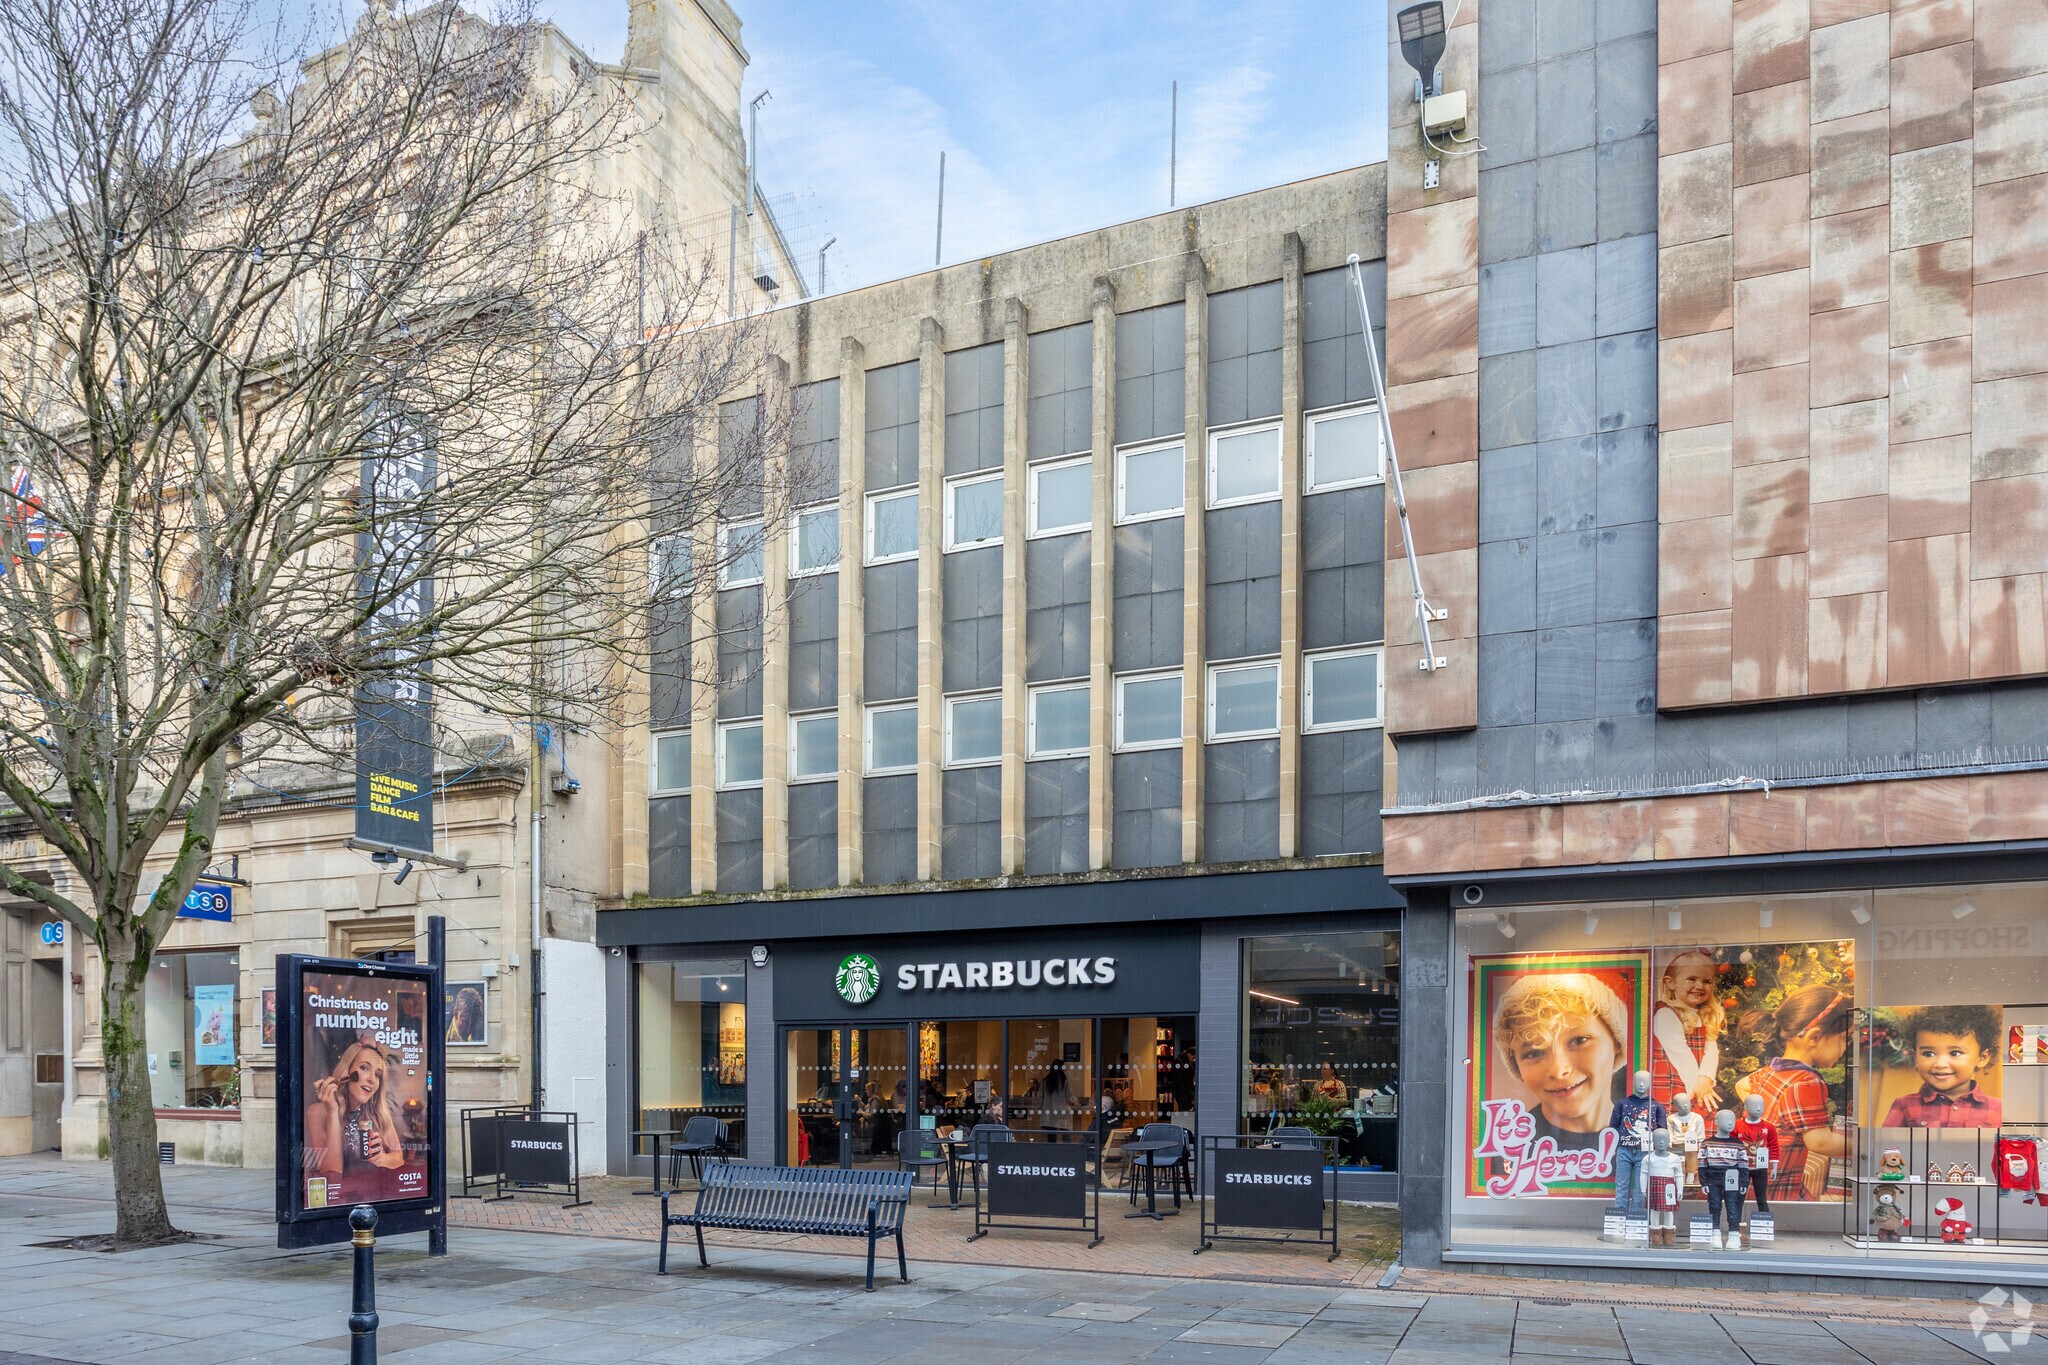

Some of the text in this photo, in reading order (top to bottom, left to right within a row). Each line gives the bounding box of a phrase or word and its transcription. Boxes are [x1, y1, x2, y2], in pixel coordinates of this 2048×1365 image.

[370, 772, 418, 793] LIVE MUSIC
[370, 782, 401, 798] DANCE
[370, 792, 391, 805] FILM
[187, 893, 225, 910] TSB
[897, 957, 1117, 990] STARBUCKS
[308, 994, 389, 1011] Christmas do
[315, 1011, 388, 1029] number
[374, 1026, 418, 1049] eight
[1477, 1102, 1532, 1154] It's
[510, 1140, 563, 1150] STARBUCKS
[997, 1164, 1077, 1177] STARBUCKS
[1489, 1130, 1615, 1195] Here!
[398, 1172, 422, 1181] COSTA
[1225, 1172, 1313, 1186] STARBUCKS
